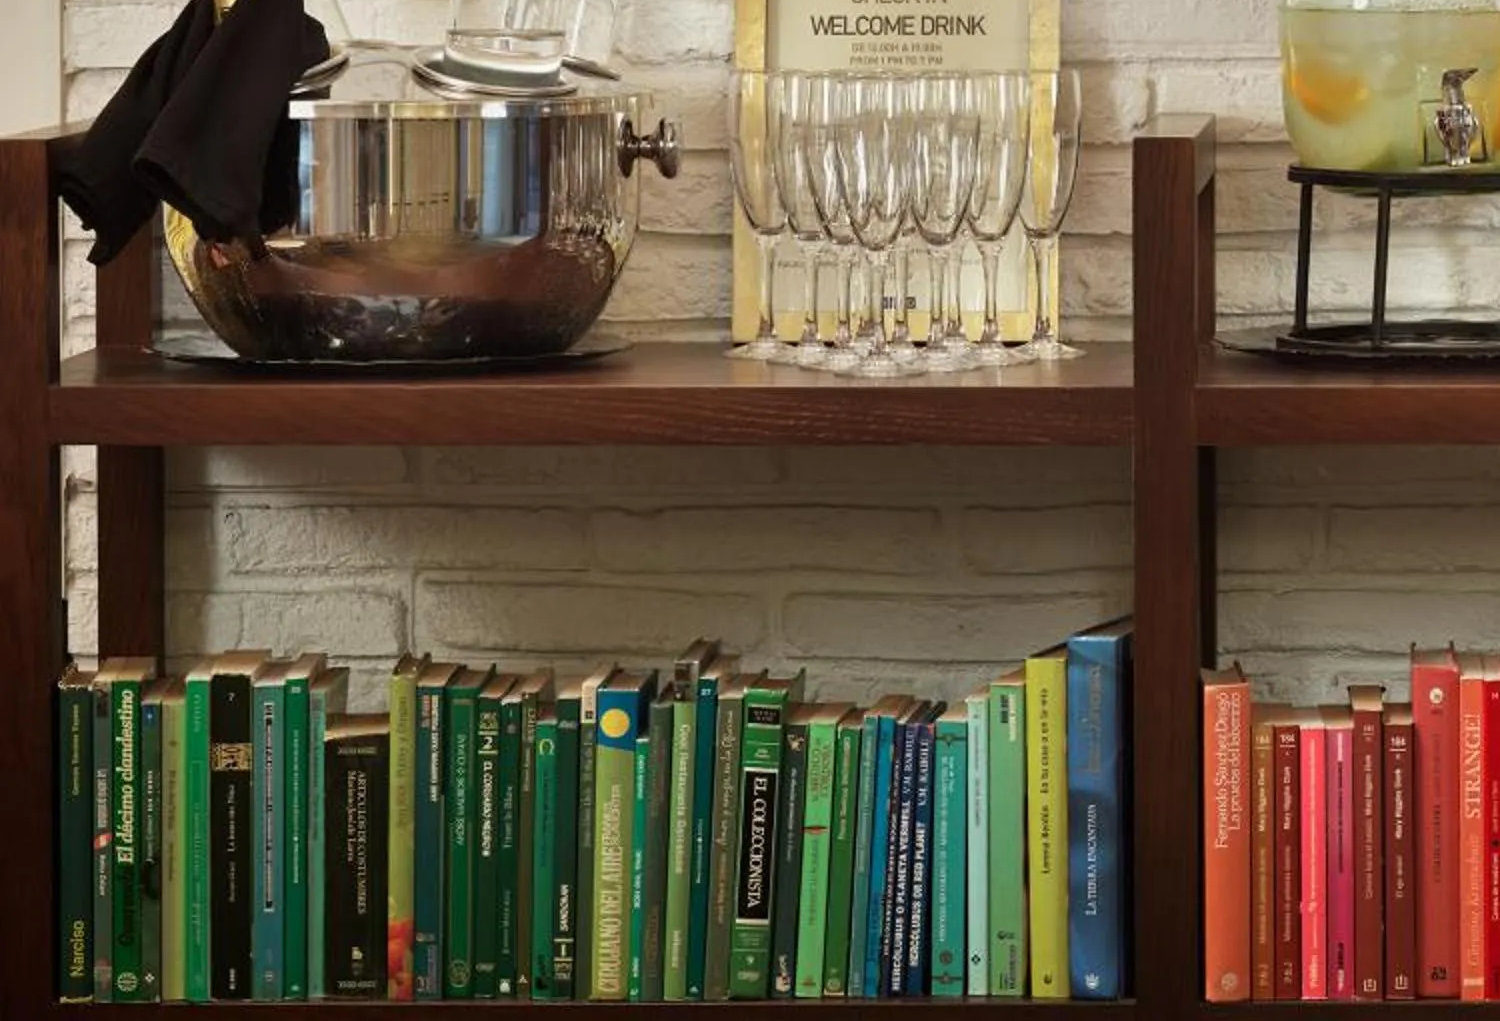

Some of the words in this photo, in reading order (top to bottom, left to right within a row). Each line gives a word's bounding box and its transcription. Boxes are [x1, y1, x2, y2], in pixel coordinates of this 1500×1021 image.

[810, 15, 915, 36] WELCOME
[921, 15, 986, 36] DRINK
[1215, 692, 1230, 733] Dragó
[116, 690, 134, 781] clandestino
[1215, 735, 1228, 786] Sánchez
[1228, 752, 1240, 772] del
[1465, 714, 1481, 819] STRANGE!
[754, 776, 768, 795] EL
[1230, 773, 1242, 813] prueba
[116, 784, 134, 843] décimo
[1215, 788, 1229, 848] Fernando
[1229, 814, 1240, 829] La
[116, 846, 134, 865] El
[747, 798, 767, 909] COLECCIONISTA
[914, 821, 926, 860] PLANET
[598, 846, 624, 881] AIRE
[598, 885, 624, 914] DEL
[68, 920, 86, 978] Narciso
[598, 917, 624, 993] CIRUJANO
